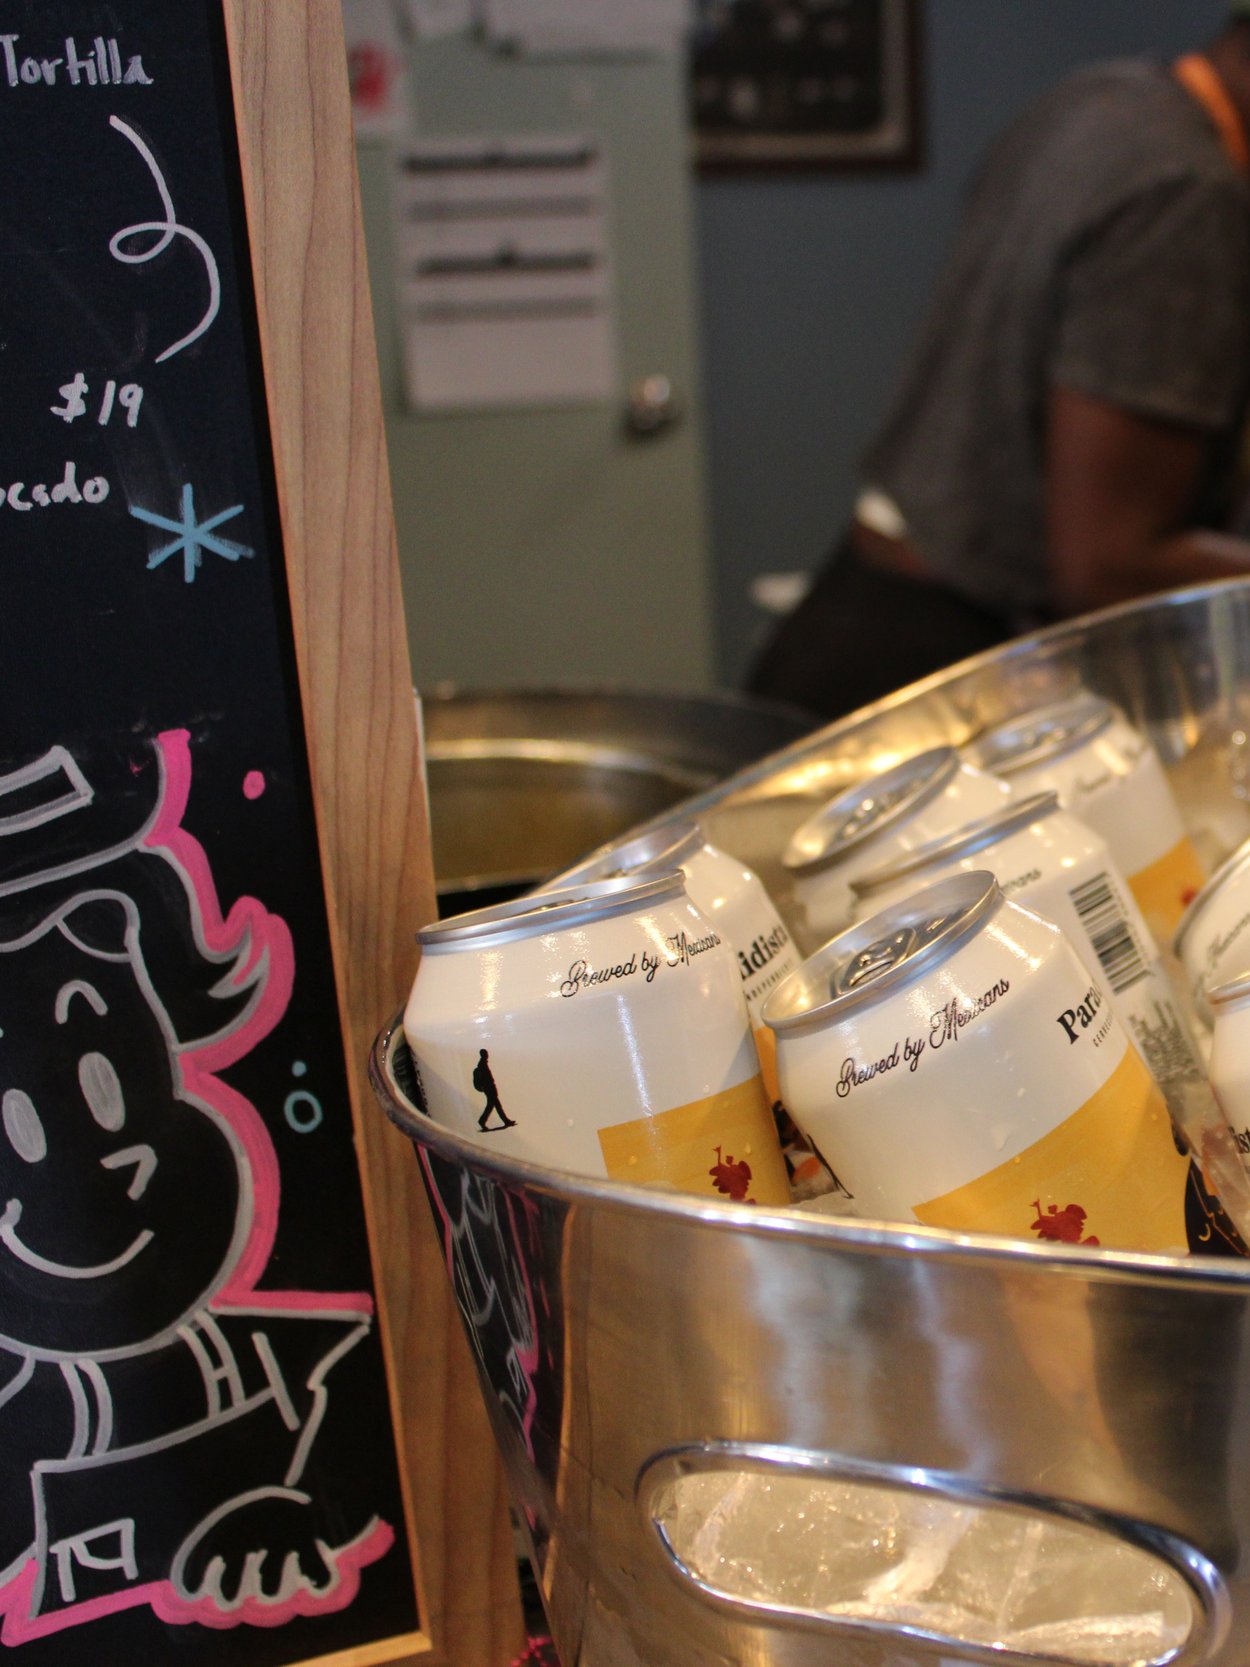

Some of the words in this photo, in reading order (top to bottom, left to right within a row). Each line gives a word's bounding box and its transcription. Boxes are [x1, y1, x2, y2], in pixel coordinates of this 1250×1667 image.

[0, 33, 155, 88] Tortilla
[49, 372, 144, 428] $19
[0, 461, 110, 511] cado
[560, 953, 637, 998] Brewed
[641, 951, 660, 983] by
[666, 931, 722, 967] Mexicans
[836, 1042, 900, 1098] Brewed
[904, 1037, 925, 1073] by
[929, 978, 1010, 1049] Mexicans
[1056, 986, 1102, 1045] Para
